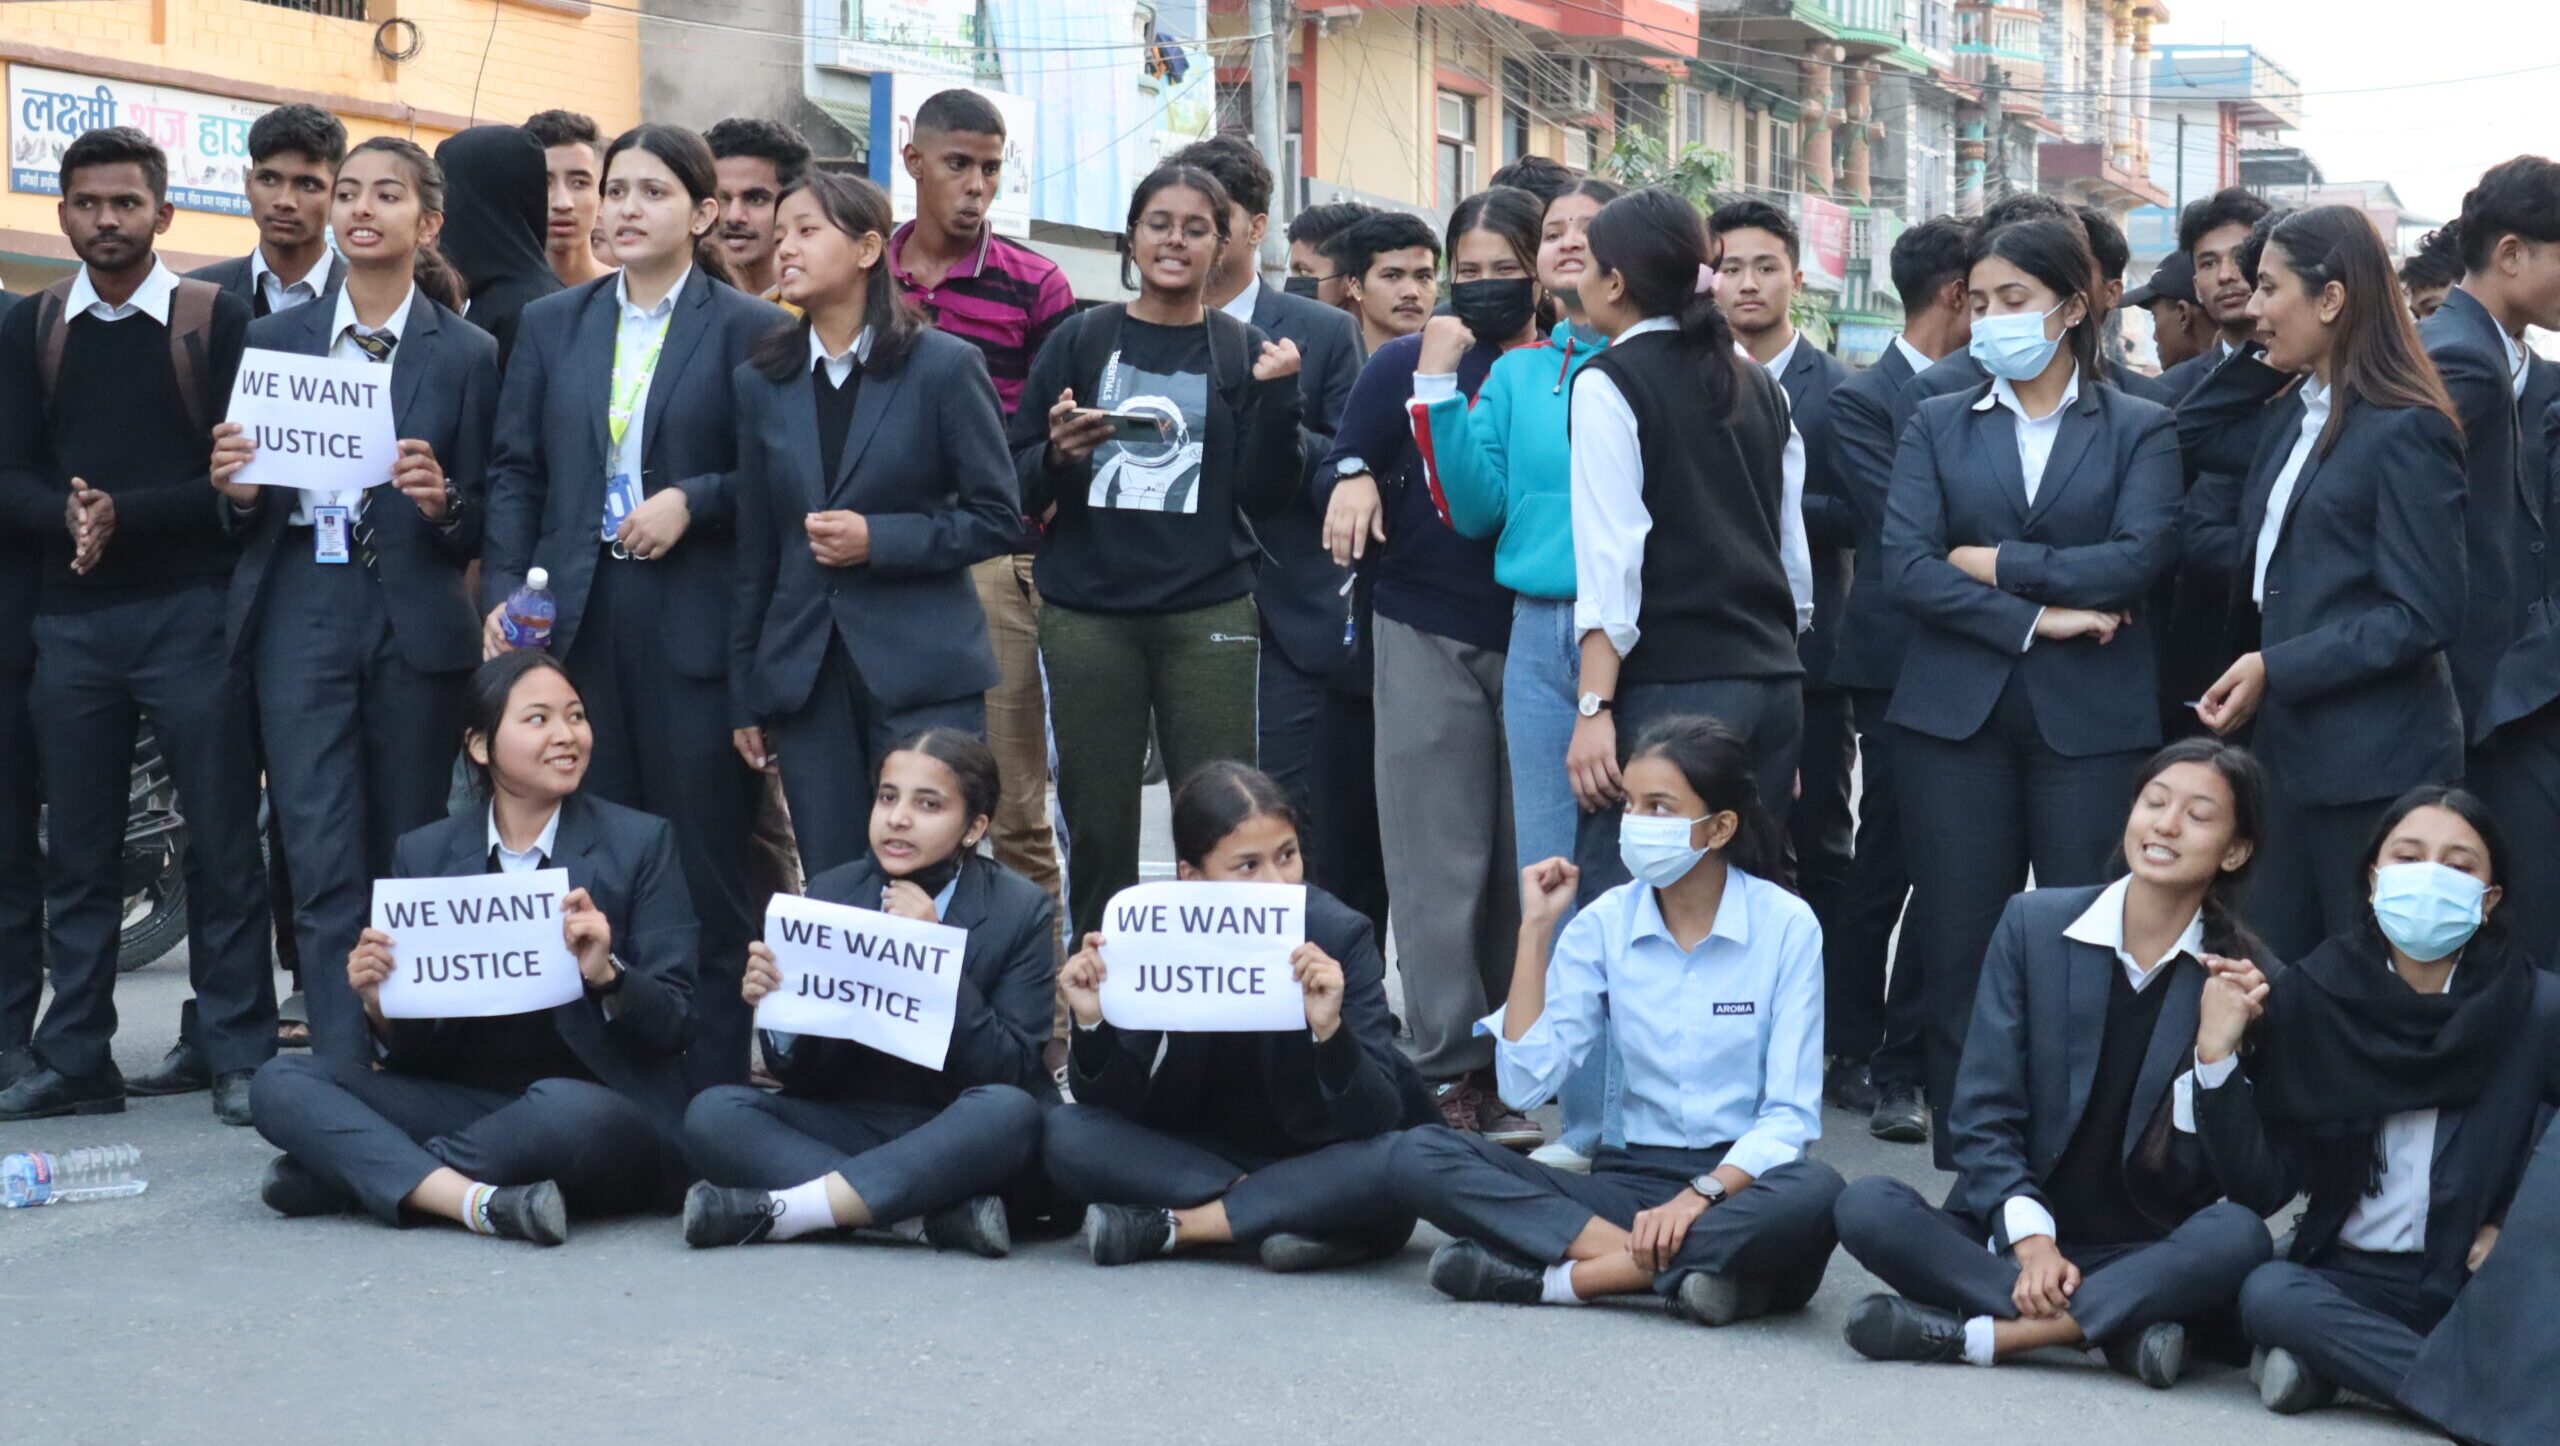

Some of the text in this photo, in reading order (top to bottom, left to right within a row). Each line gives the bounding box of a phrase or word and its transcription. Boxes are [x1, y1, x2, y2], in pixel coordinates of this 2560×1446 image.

[198, 113, 253, 156] हाउ
[242, 369, 378, 409] WE WANT
[255, 425, 363, 459] JUSTICE
[384, 892, 555, 928] WE WANT
[1118, 905, 1290, 935] WE WANT
[781, 916, 950, 974] WE WANT
[413, 950, 542, 984] JUSTICE
[1135, 965, 1266, 995] JUSTICE
[797, 973, 922, 1023] JUSTICE
[1716, 1003, 1753, 1014] AROMA
